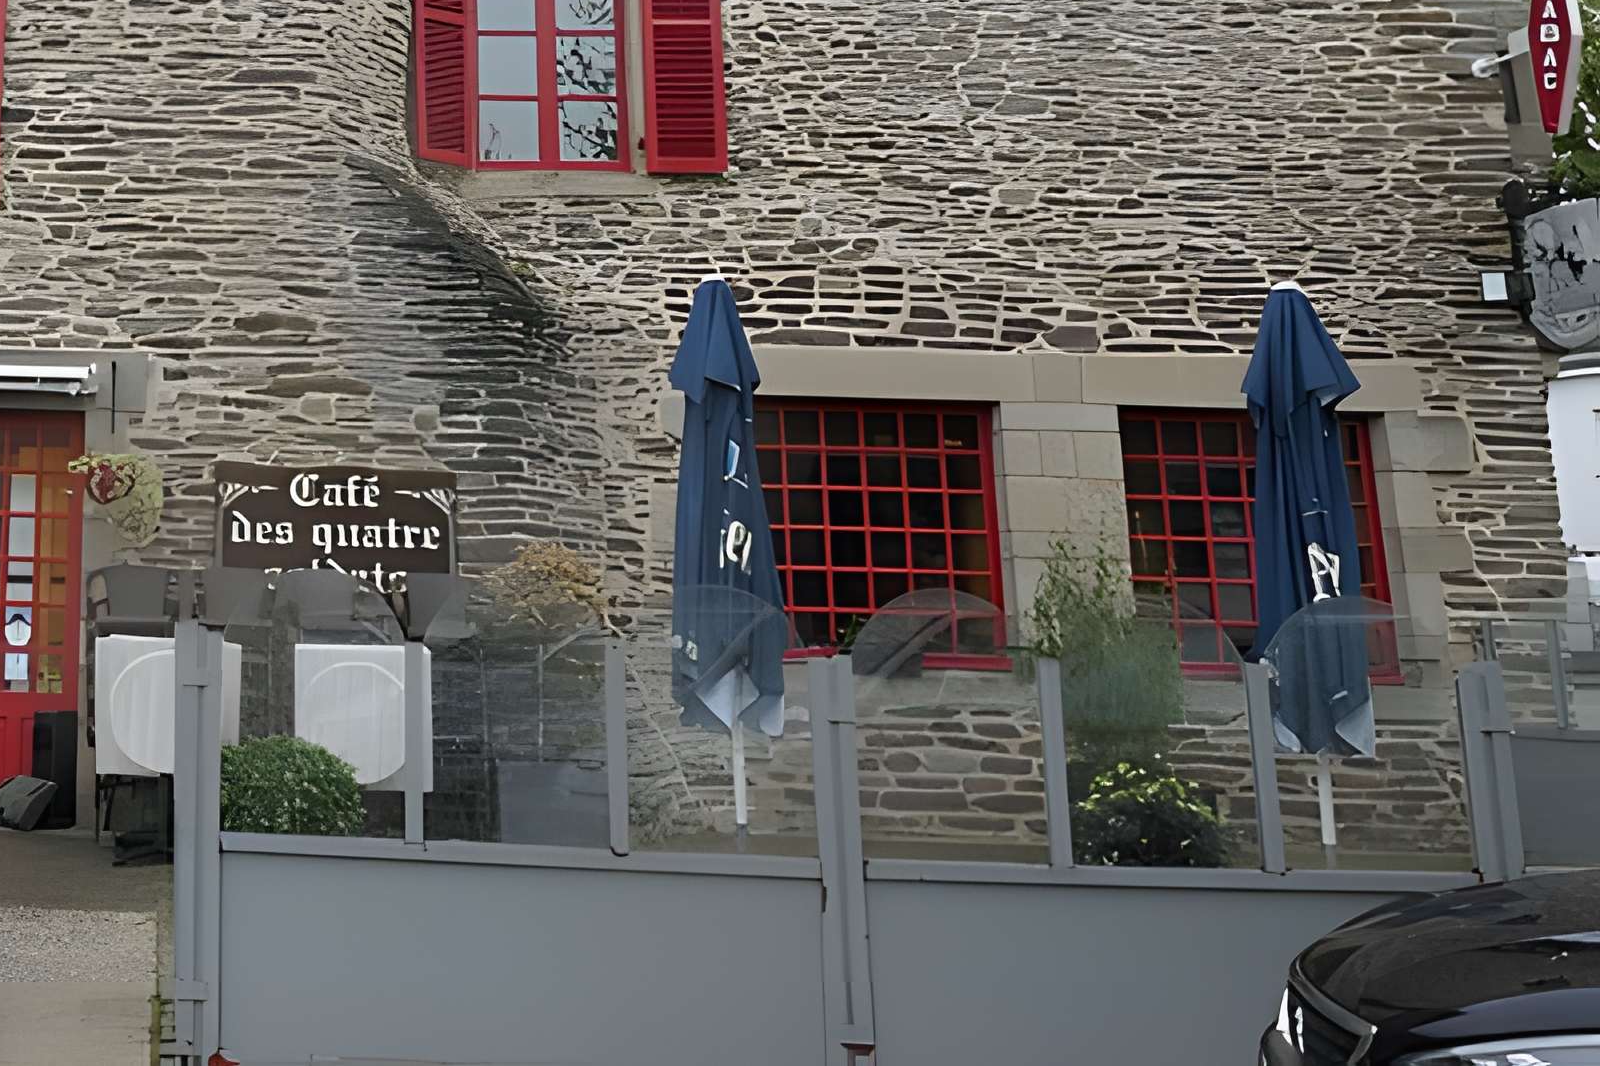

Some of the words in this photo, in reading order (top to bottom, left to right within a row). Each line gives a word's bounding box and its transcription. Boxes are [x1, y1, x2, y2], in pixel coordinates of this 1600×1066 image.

[289, 473, 381, 508] Café
[231, 510, 295, 545] des
[311, 517, 441, 554] quatre
